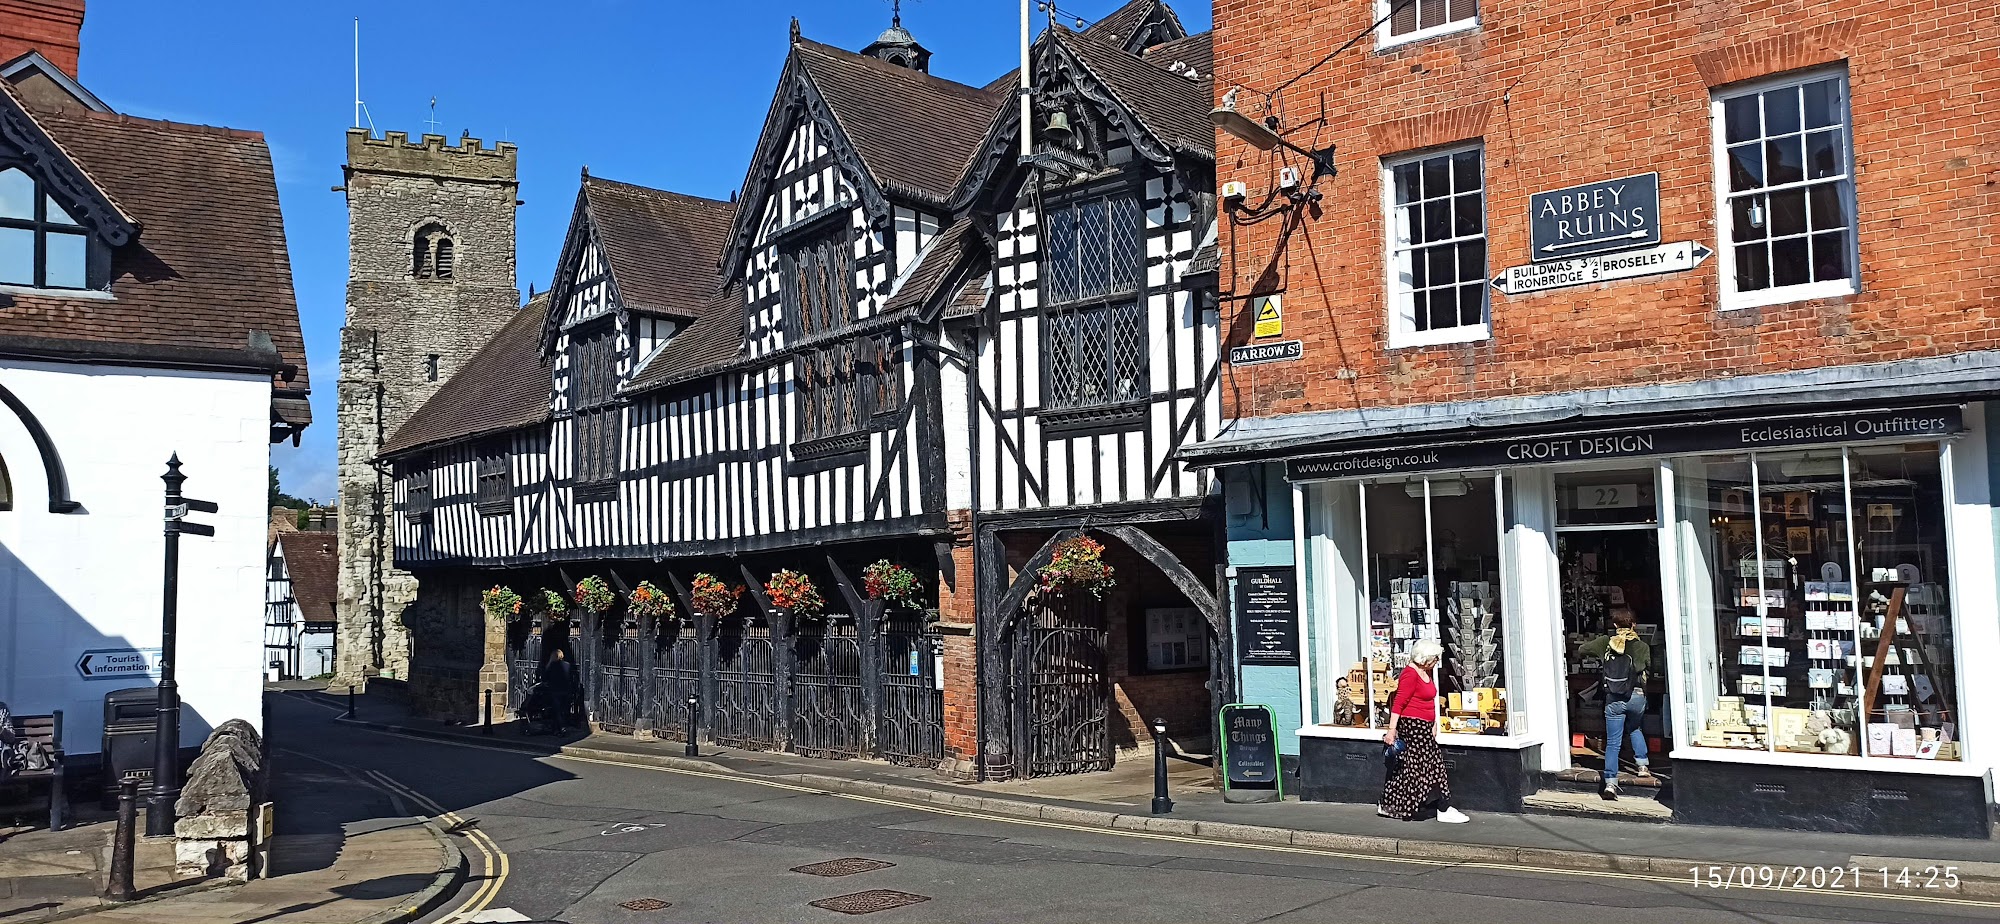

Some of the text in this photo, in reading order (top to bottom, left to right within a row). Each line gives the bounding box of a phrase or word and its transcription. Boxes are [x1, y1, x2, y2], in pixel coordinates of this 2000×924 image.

[1540, 184, 1626, 218] ABBEY
[1558, 207, 1645, 240] RUINS
[1514, 260, 1573, 279] BUILDWAS
[1603, 250, 1684, 271] BROSELEY 4
[1514, 268, 1599, 290] IRONBRIDGE 5
[1232, 345, 1285, 362] BARROW
[1741, 416, 1946, 443] Ecclesiastical Outfitters
[1506, 434, 1654, 461] CROFT DESIGN
[1297, 451, 1440, 474] www.croftdesign.co.uk
[1594, 487, 1620, 506] 22
[94, 663, 150, 673] information
[106, 655, 140, 663] Tourist
[1233, 716, 1263, 729] Many
[1231, 730, 1267, 744] Things
